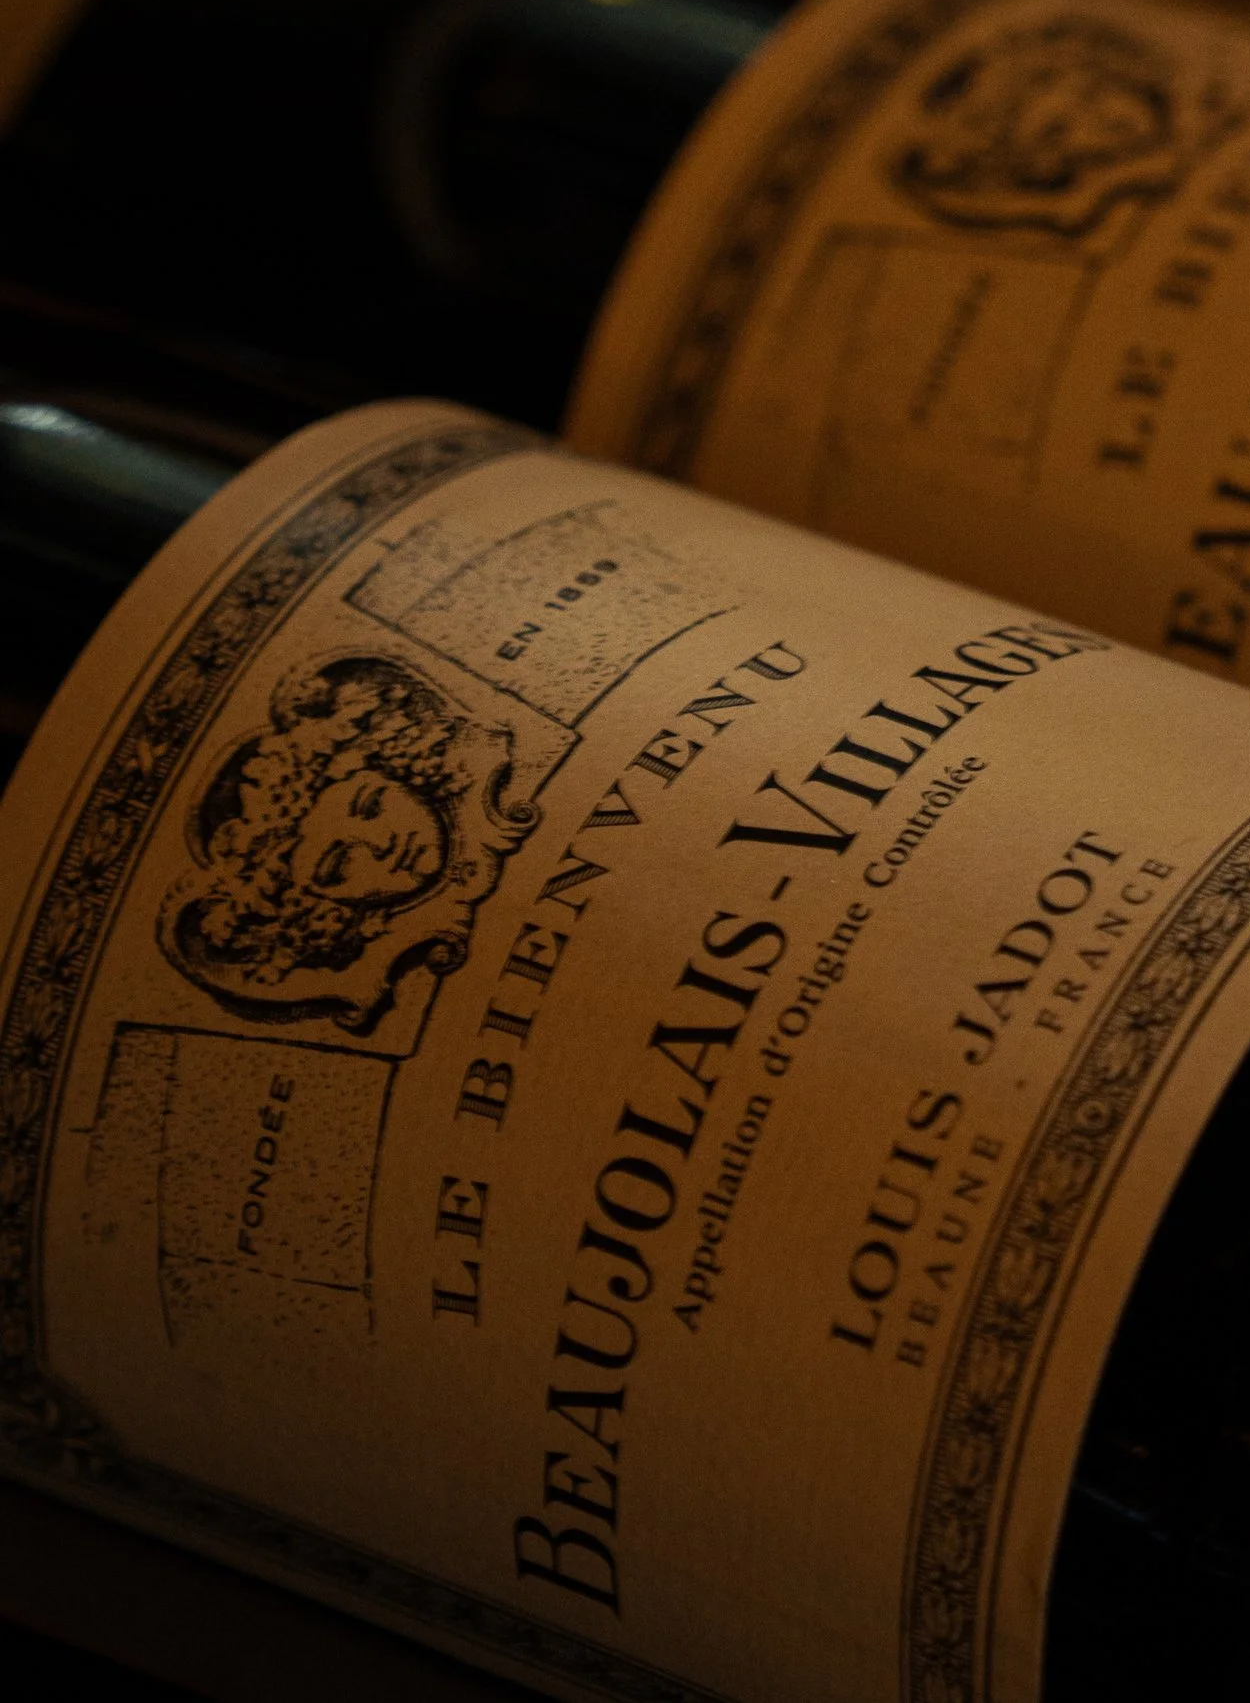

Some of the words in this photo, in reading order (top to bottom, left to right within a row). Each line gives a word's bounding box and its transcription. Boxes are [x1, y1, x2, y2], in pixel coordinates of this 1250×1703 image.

[454, 640, 809, 1133] BIENVENU
[496, 621, 543, 661] EN
[237, 1073, 296, 1257] FONDÉE
[432, 1175, 490, 1328] LE
[672, 1093, 773, 1334] Appellation
[760, 901, 874, 1078] d'Origine
[862, 754, 987, 890] Contrôlée
[830, 1088, 964, 1353] LOUIS
[952, 830, 1125, 1067] JADOT
[896, 1133, 1004, 1369] BEAUNE
[1034, 857, 1177, 1036] FRANCE
